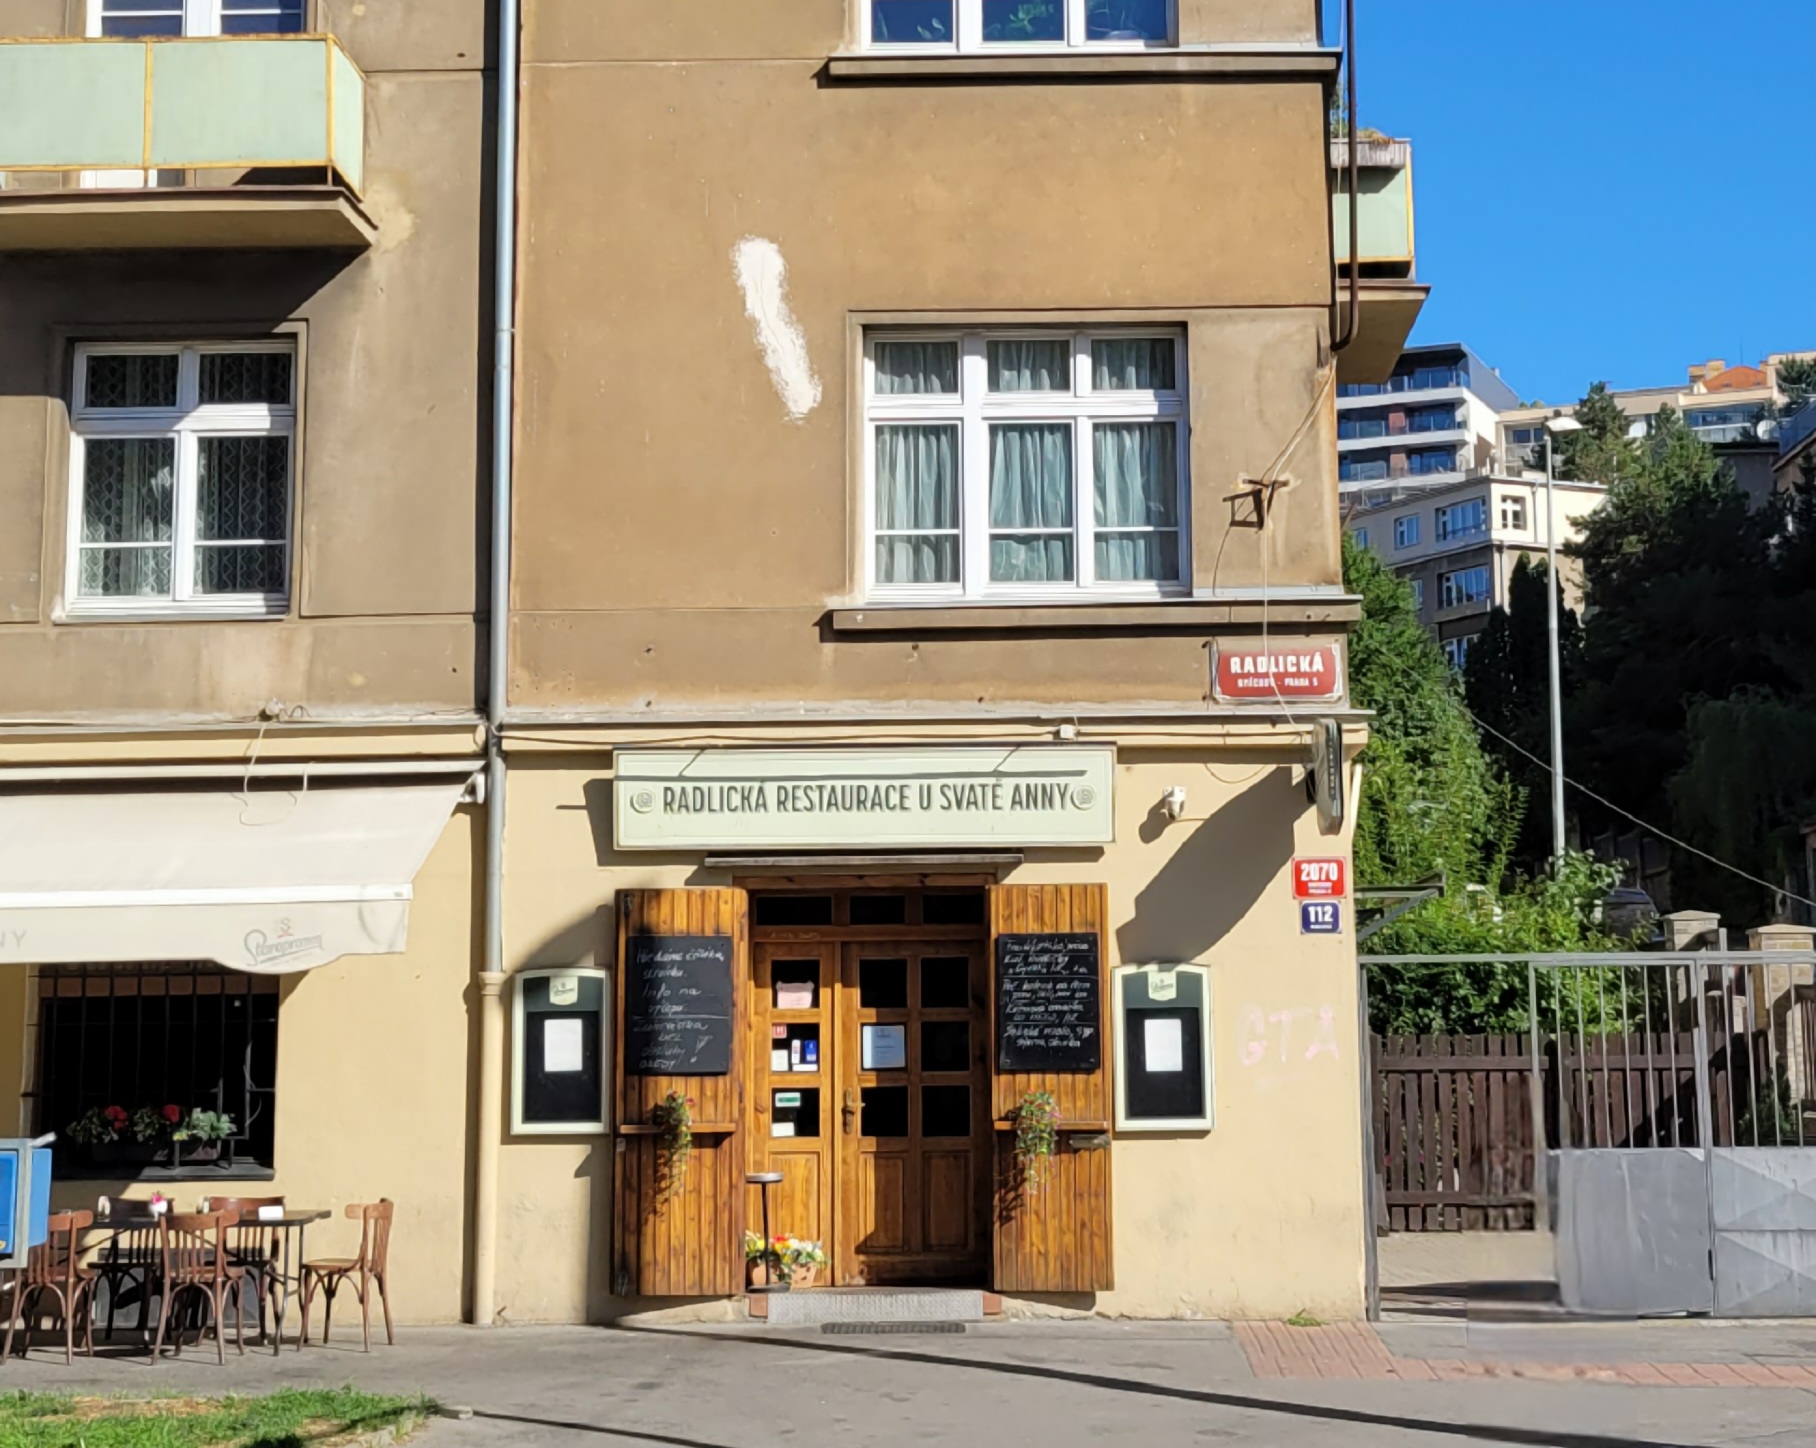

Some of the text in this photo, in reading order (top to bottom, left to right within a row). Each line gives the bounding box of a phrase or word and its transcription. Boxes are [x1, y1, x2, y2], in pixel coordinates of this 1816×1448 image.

[1230, 651, 1325, 674] RADLICKÁ
[776, 784, 912, 813] RESTAURACE
[918, 783, 932, 811] U
[1010, 782, 1070, 811] ANNY
[1300, 862, 1339, 882] 2070
[1308, 905, 1334, 923] 112
